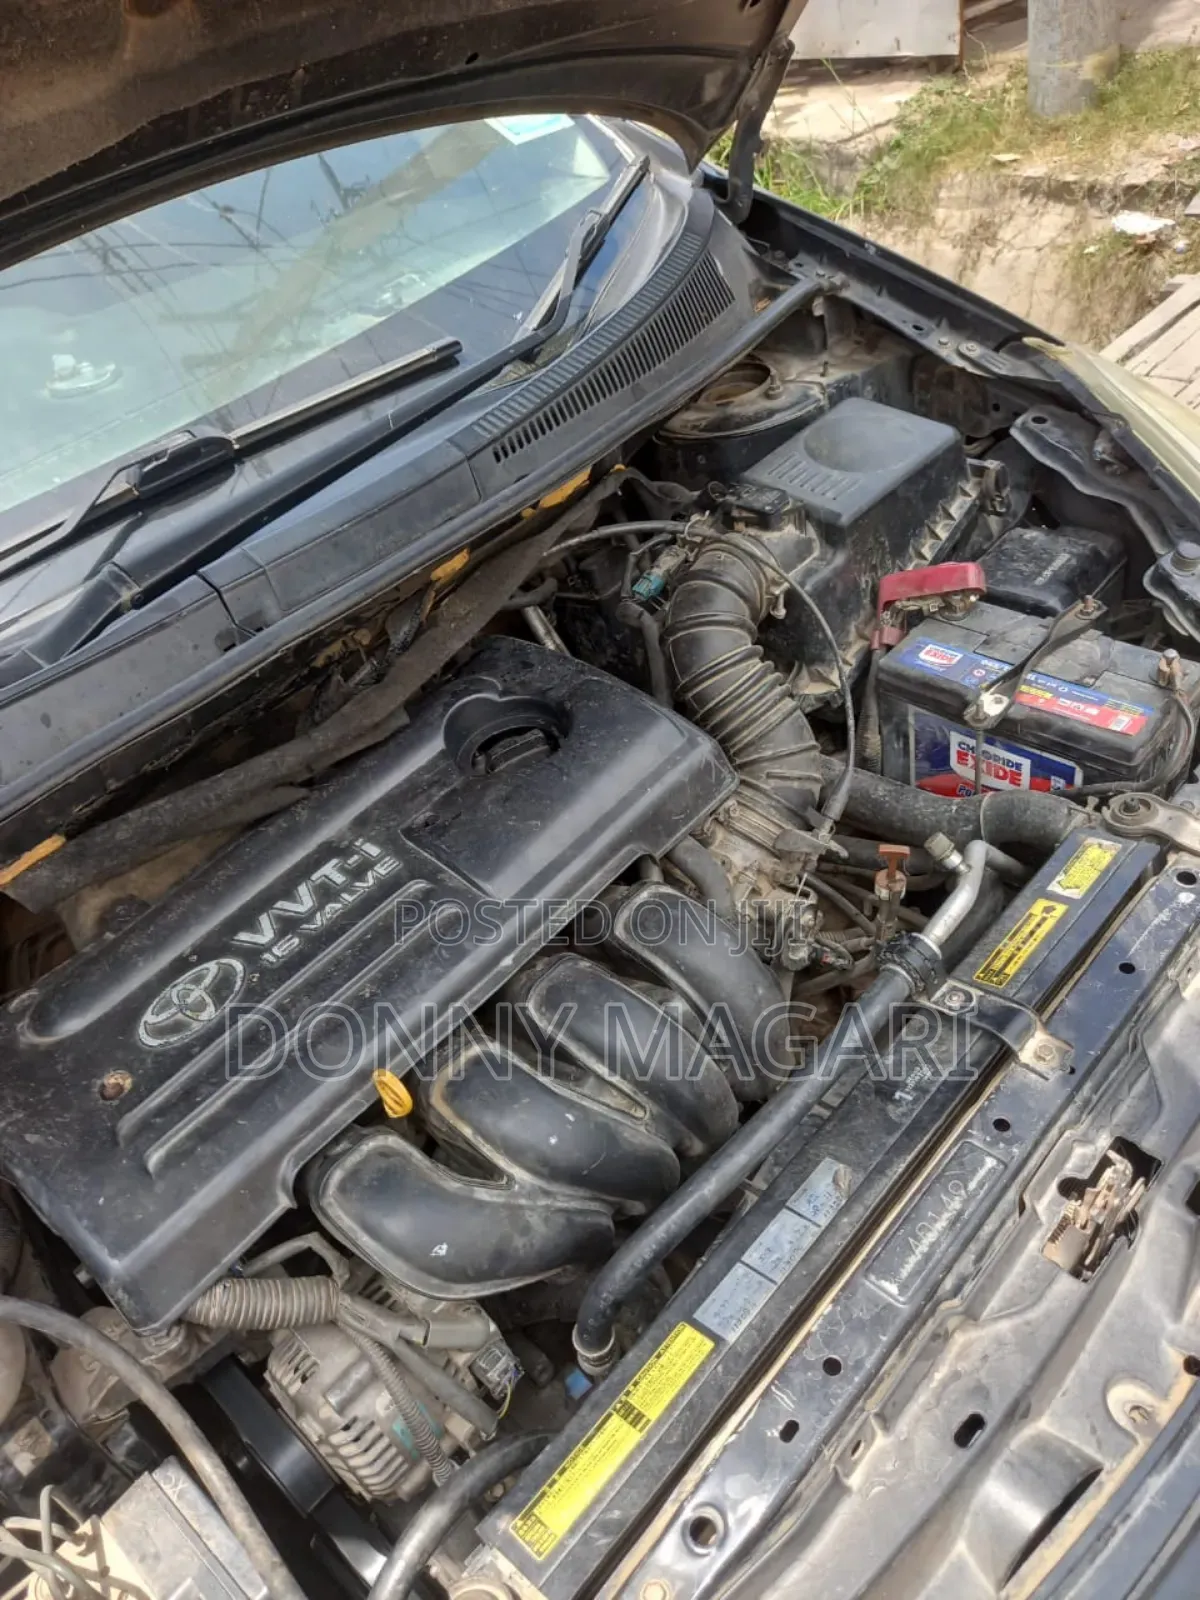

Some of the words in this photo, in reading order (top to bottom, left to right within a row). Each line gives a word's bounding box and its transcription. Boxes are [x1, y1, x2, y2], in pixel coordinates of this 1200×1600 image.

[957, 741, 1022, 772] CHORIDE
[231, 838, 383, 947] VVT-i
[261, 934, 300, 963] 16
[299, 856, 402, 932] VALVE
